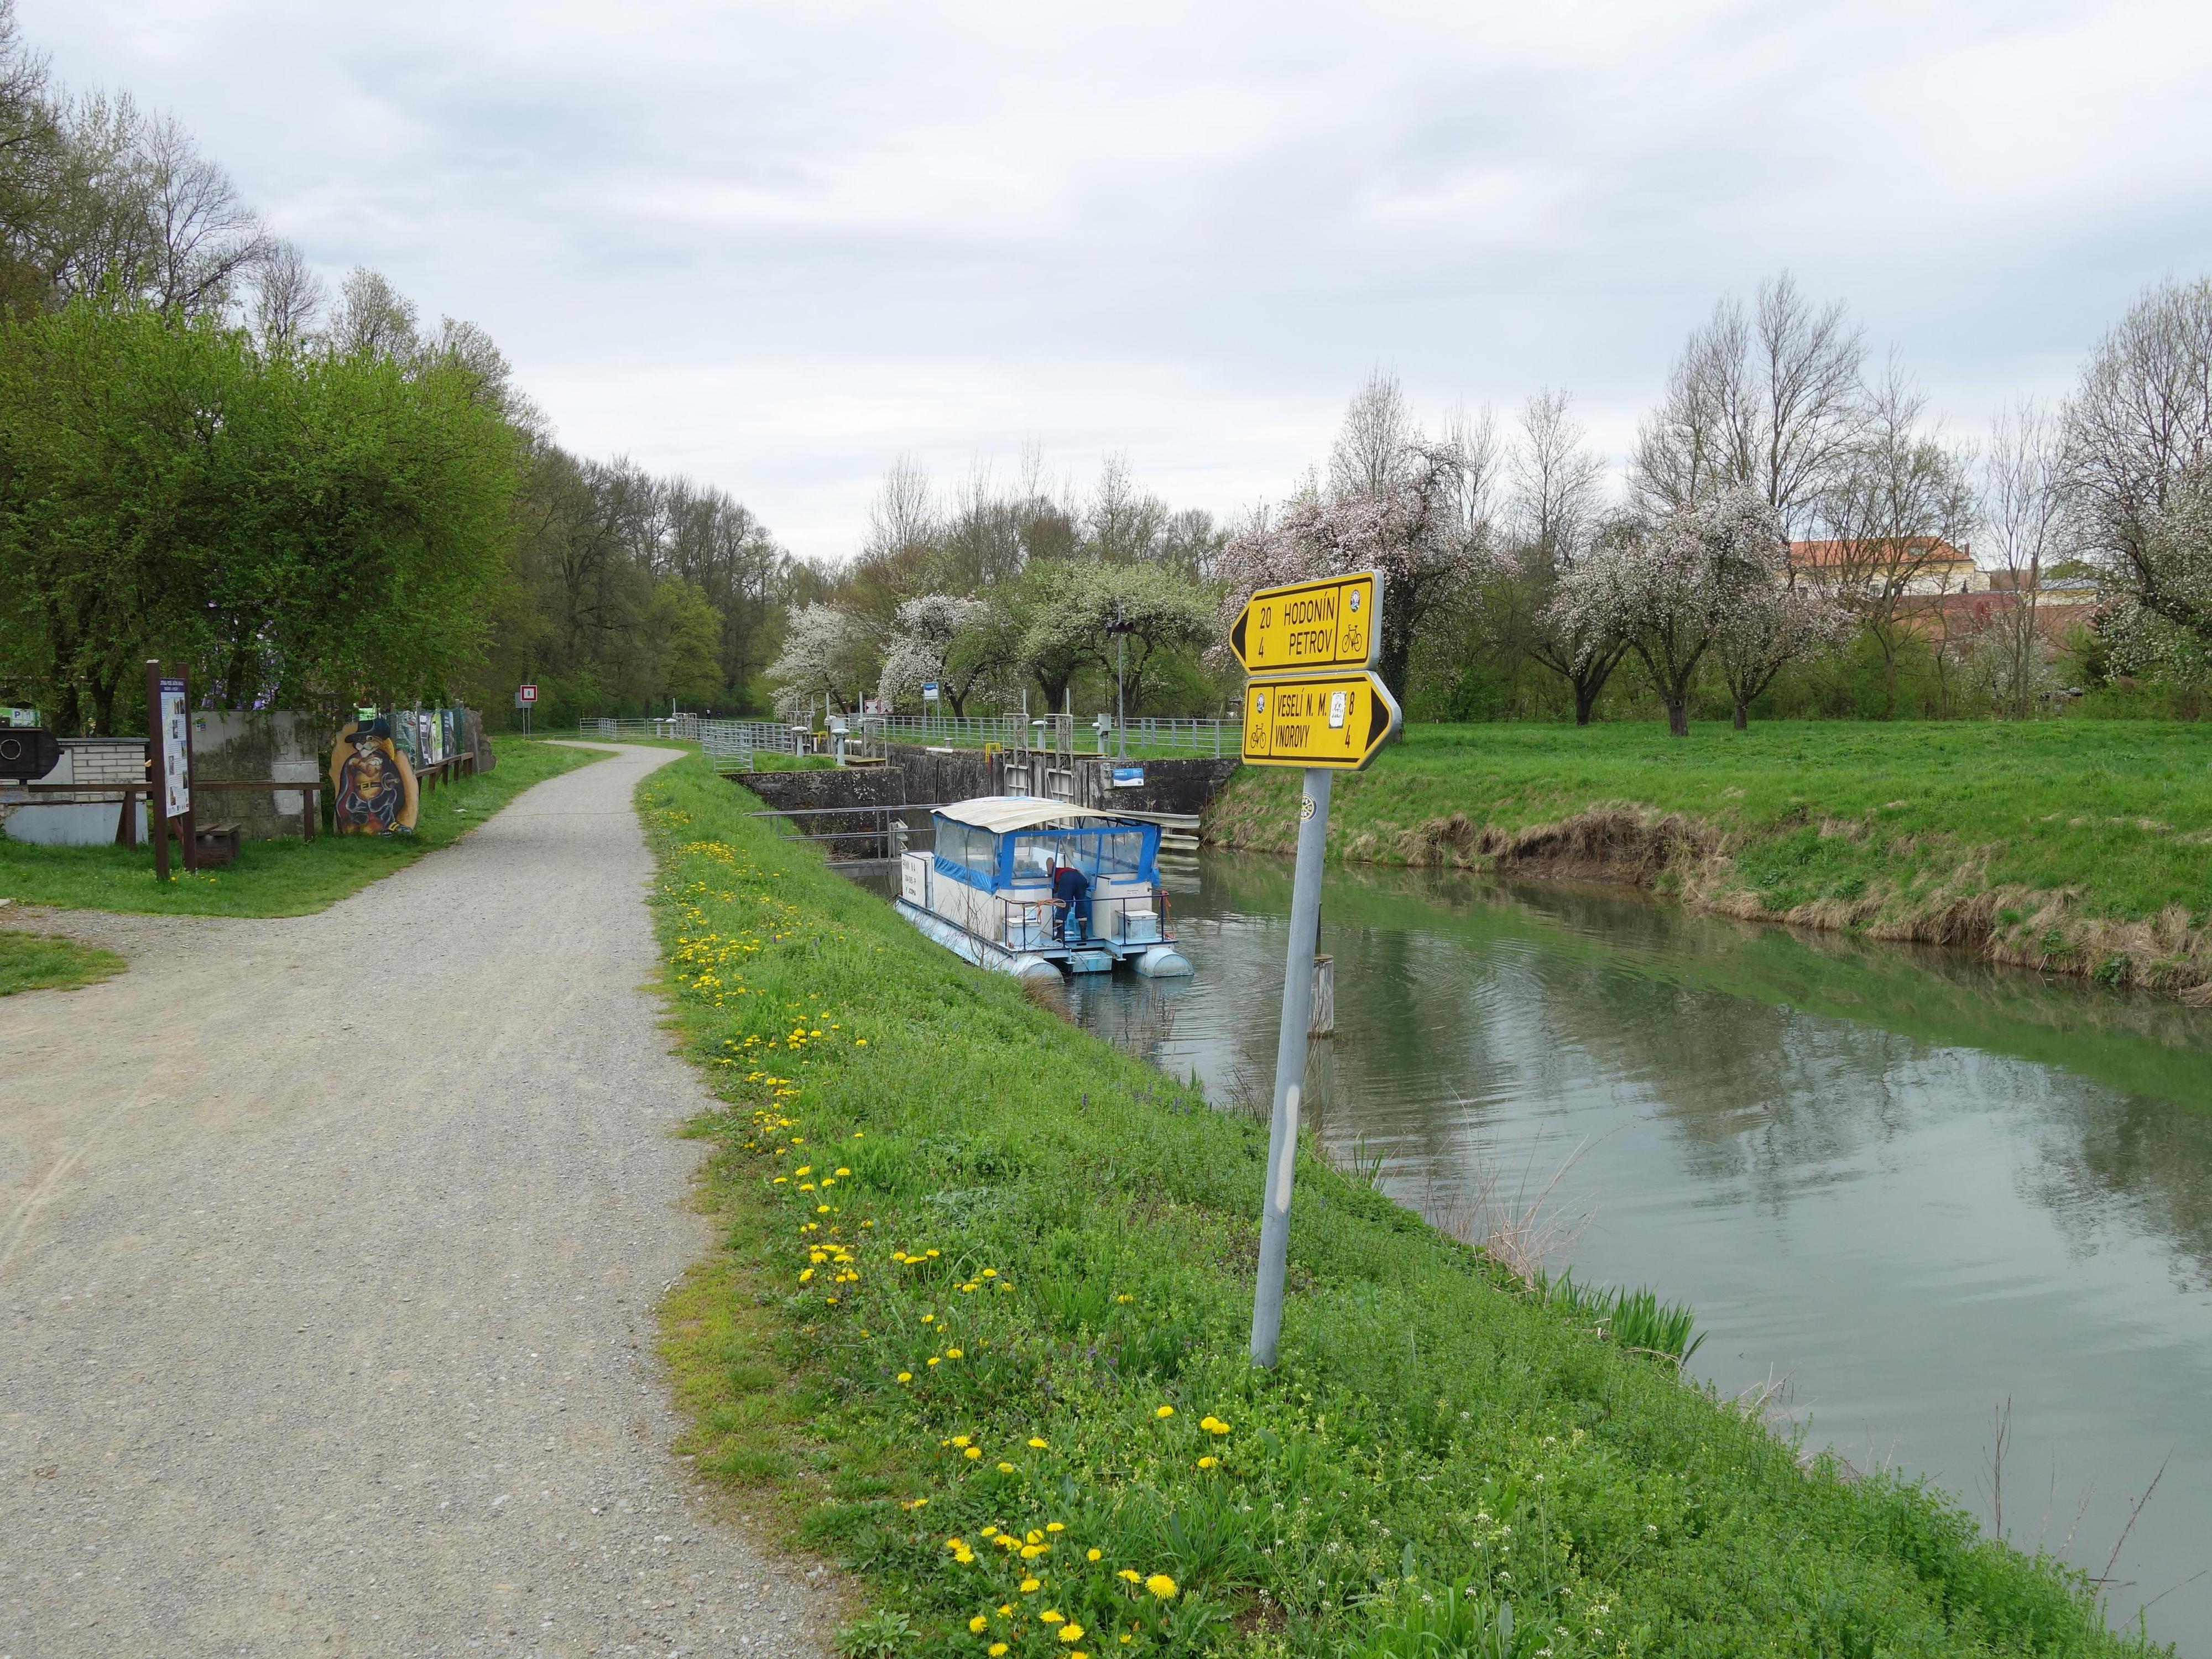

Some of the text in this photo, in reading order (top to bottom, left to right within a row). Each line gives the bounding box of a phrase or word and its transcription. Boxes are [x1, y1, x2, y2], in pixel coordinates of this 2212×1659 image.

[1260, 607, 1271, 629] 20
[1284, 591, 1335, 626] HODONÍN
[1258, 628, 1333, 658] 4 PETROV
[1277, 687, 1305, 717] VESELÍ
[1306, 693, 1313, 717] N.
[1317, 692, 1327, 717] M.
[1348, 691, 1355, 716] 8
[1275, 724, 1350, 749] VNOROVY 4
